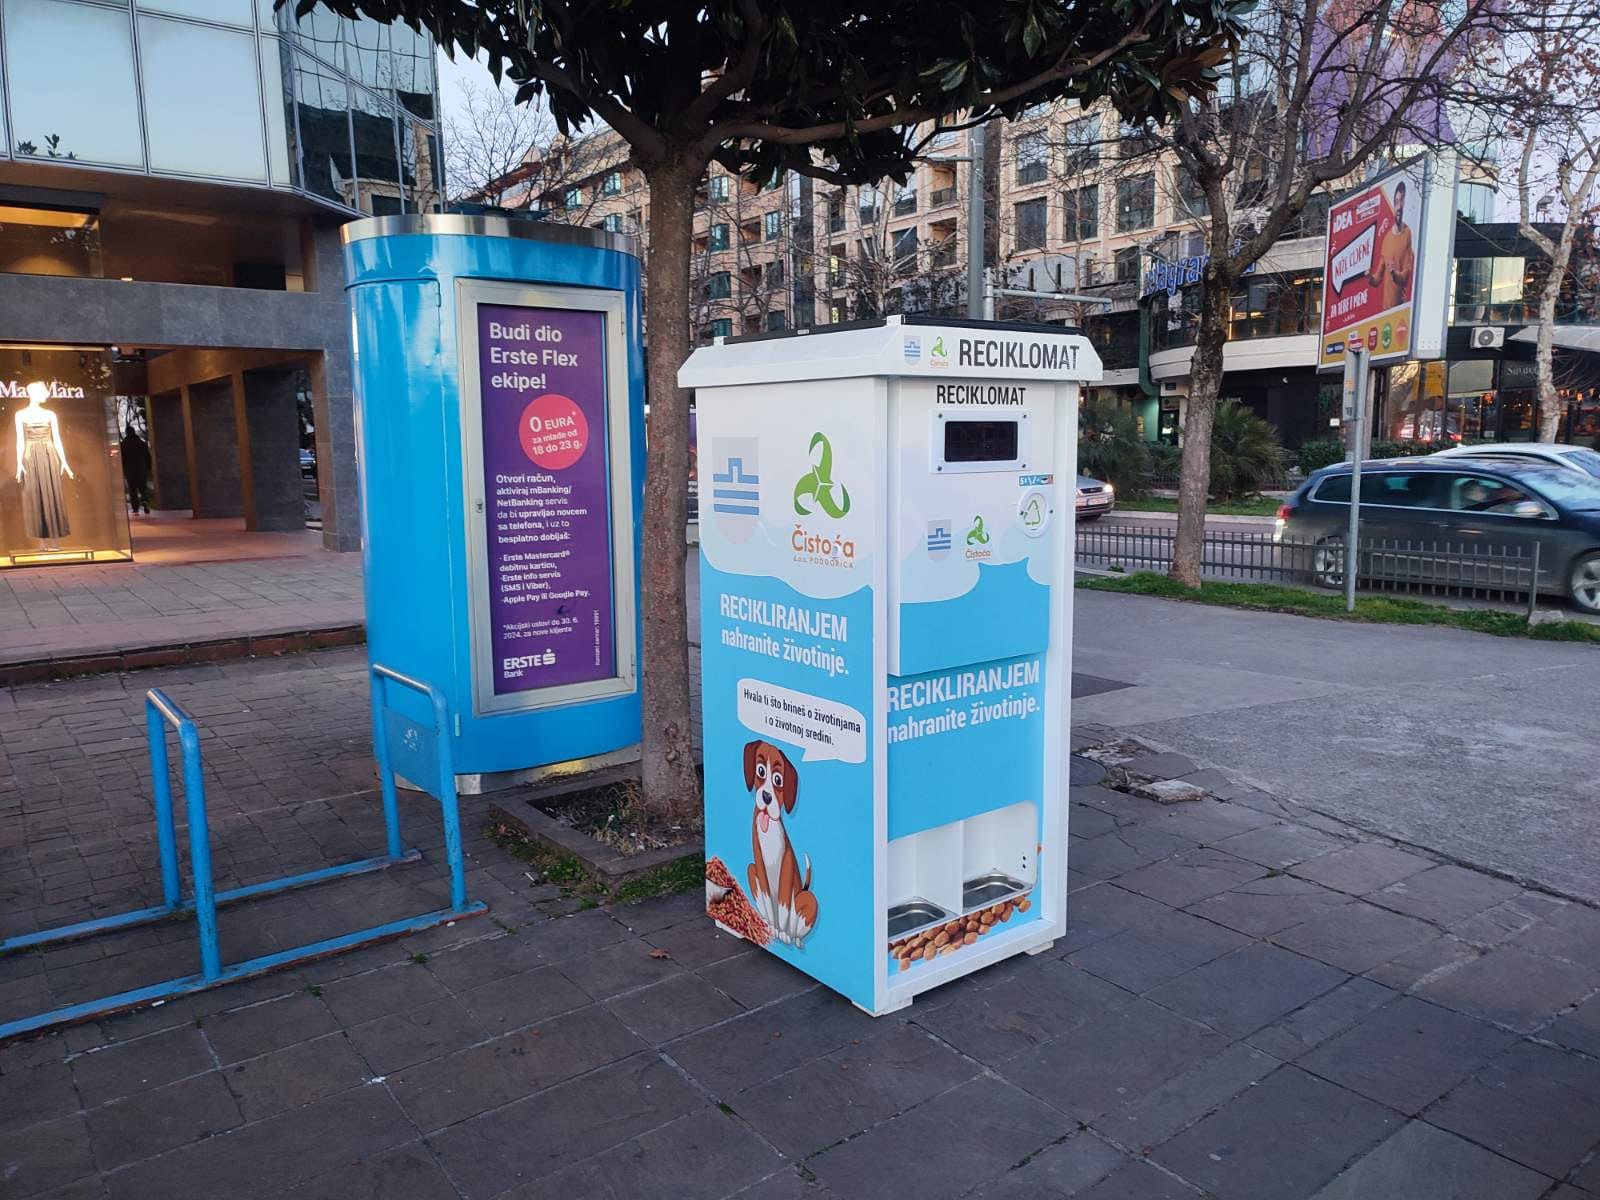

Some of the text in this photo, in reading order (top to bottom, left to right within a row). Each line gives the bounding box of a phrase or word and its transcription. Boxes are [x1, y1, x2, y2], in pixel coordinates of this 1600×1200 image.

[489, 322, 562, 342] Budi dio
[490, 347, 578, 367] Erste Flex
[959, 338, 1080, 370] RECIKLOMAT
[491, 372, 546, 393] ekipe!
[936, 385, 1026, 406] RECIKLOMAT
[529, 416, 542, 432] 0
[532, 445, 544, 455] 18
[545, 443, 558, 453] do
[559, 440, 572, 450] 23
[496, 473, 556, 484] Otvori račun,
[496, 486, 528, 496] aktiviraj
[497, 497, 568, 507] NetBanking servis
[497, 508, 587, 519] da bi upravljao novcem
[509, 521, 545, 530] telefona,
[498, 535, 538, 544] besplatno
[503, 553, 523, 562] Erste
[523, 572, 538, 580] info
[539, 571, 561, 579] servis
[526, 594, 540, 602] Pay
[549, 590, 575, 600] Google
[720, 593, 848, 642] RECIKLIRANJEM
[721, 626, 849, 677] nahranite životinje.
[503, 654, 541, 670] ERSTE
[503, 670, 523, 679] Bank
[887, 660, 1040, 713] RECIKLIRANJEM
[744, 688, 861, 733] Hvala ti što brineš o životinjama
[887, 692, 1040, 744] nahranite životinje.
[769, 716, 774, 725] o
[775, 716, 804, 738] životnoj
[806, 728, 835, 746] sredini.
